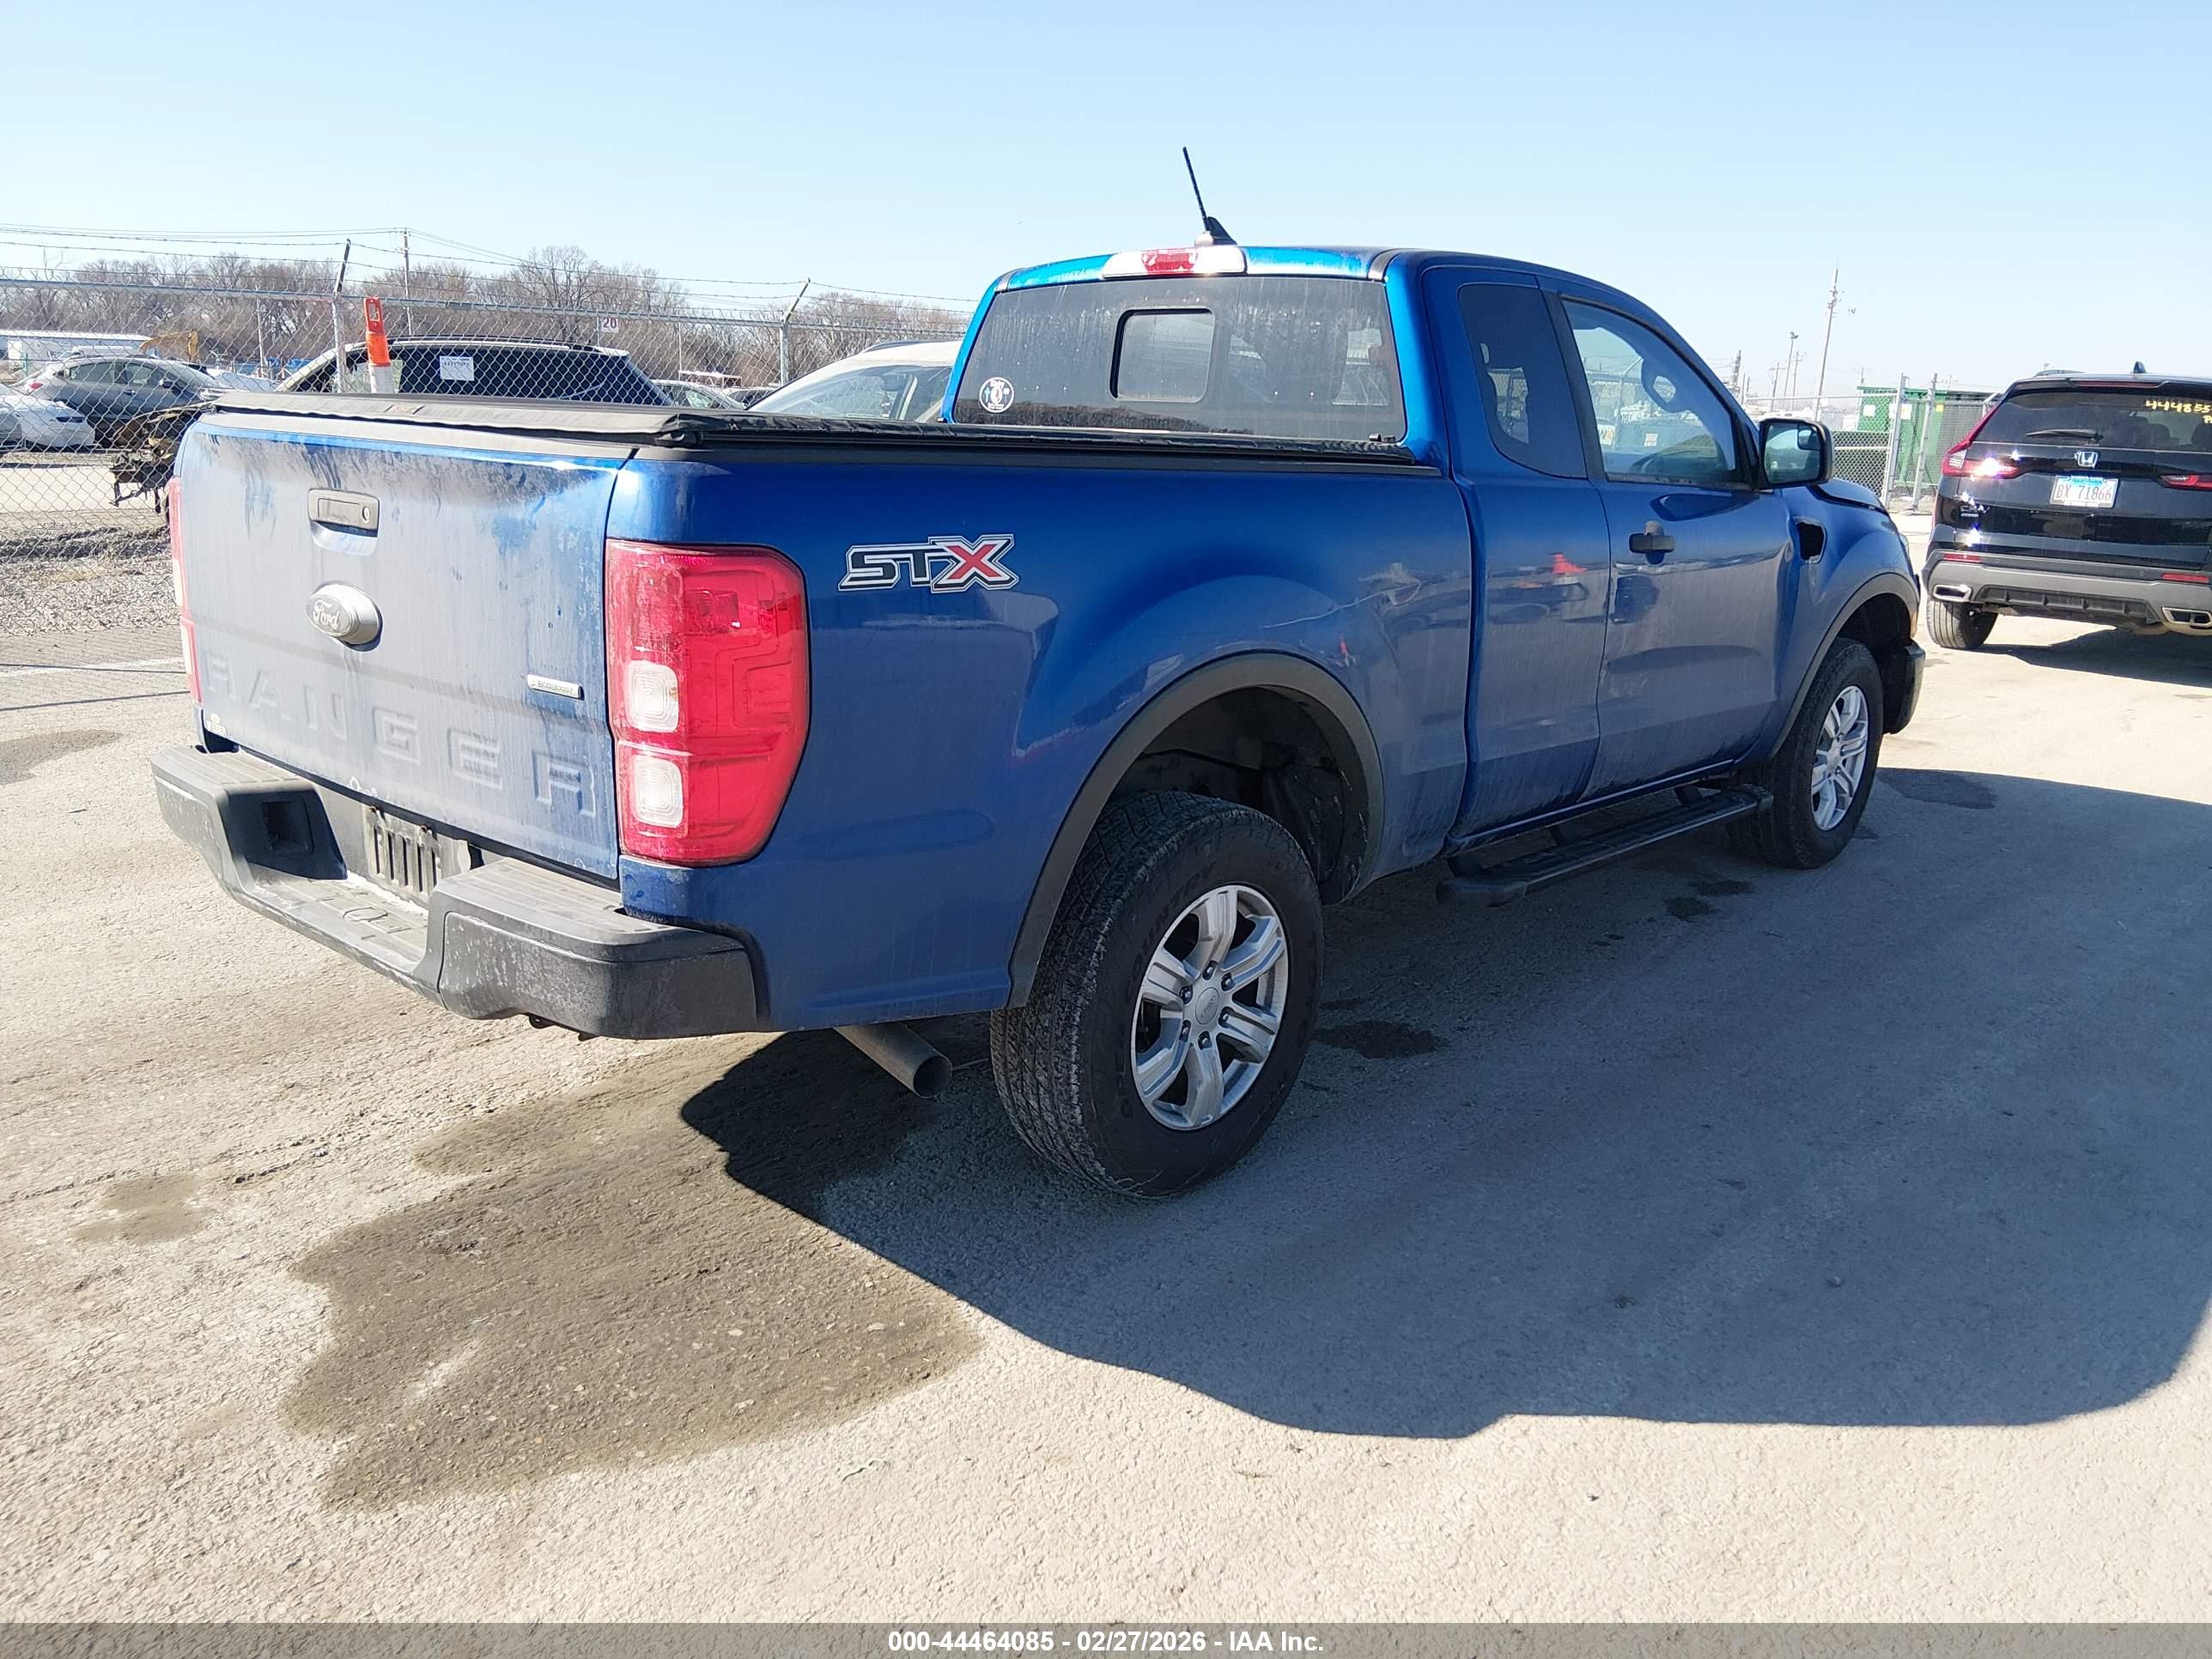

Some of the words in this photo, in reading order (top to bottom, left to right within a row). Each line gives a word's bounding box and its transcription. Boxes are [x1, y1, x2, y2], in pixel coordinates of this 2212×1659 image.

[603, 316, 617, 329] 20
[2145, 399, 2212, 413] 444855
[2078, 484, 2112, 501] 71866
[838, 533, 1019, 593] STX
[313, 599, 341, 630] Ford
[204, 653, 598, 818] RANGER
